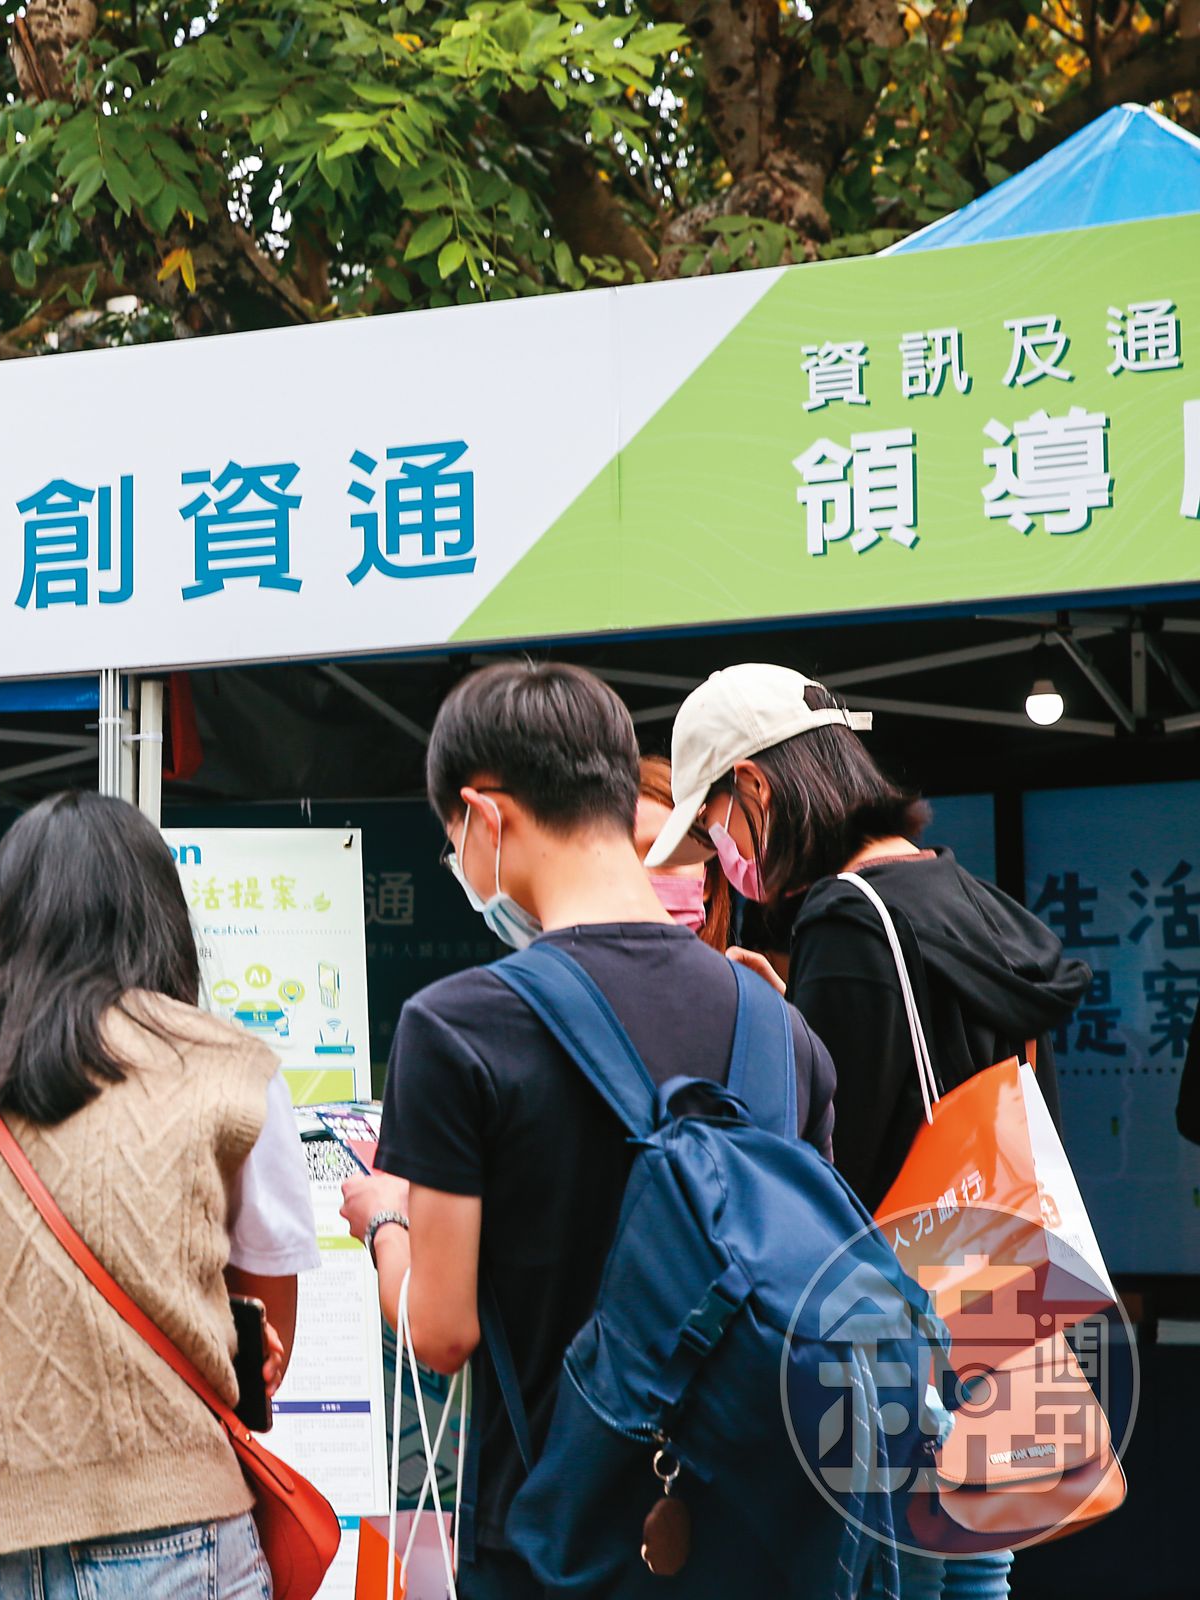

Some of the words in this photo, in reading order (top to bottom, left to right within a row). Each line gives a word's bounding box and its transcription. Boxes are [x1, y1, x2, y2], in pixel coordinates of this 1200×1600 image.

[801, 299, 1184, 411] 資訊及通
[792, 398, 1200, 556] 領導
